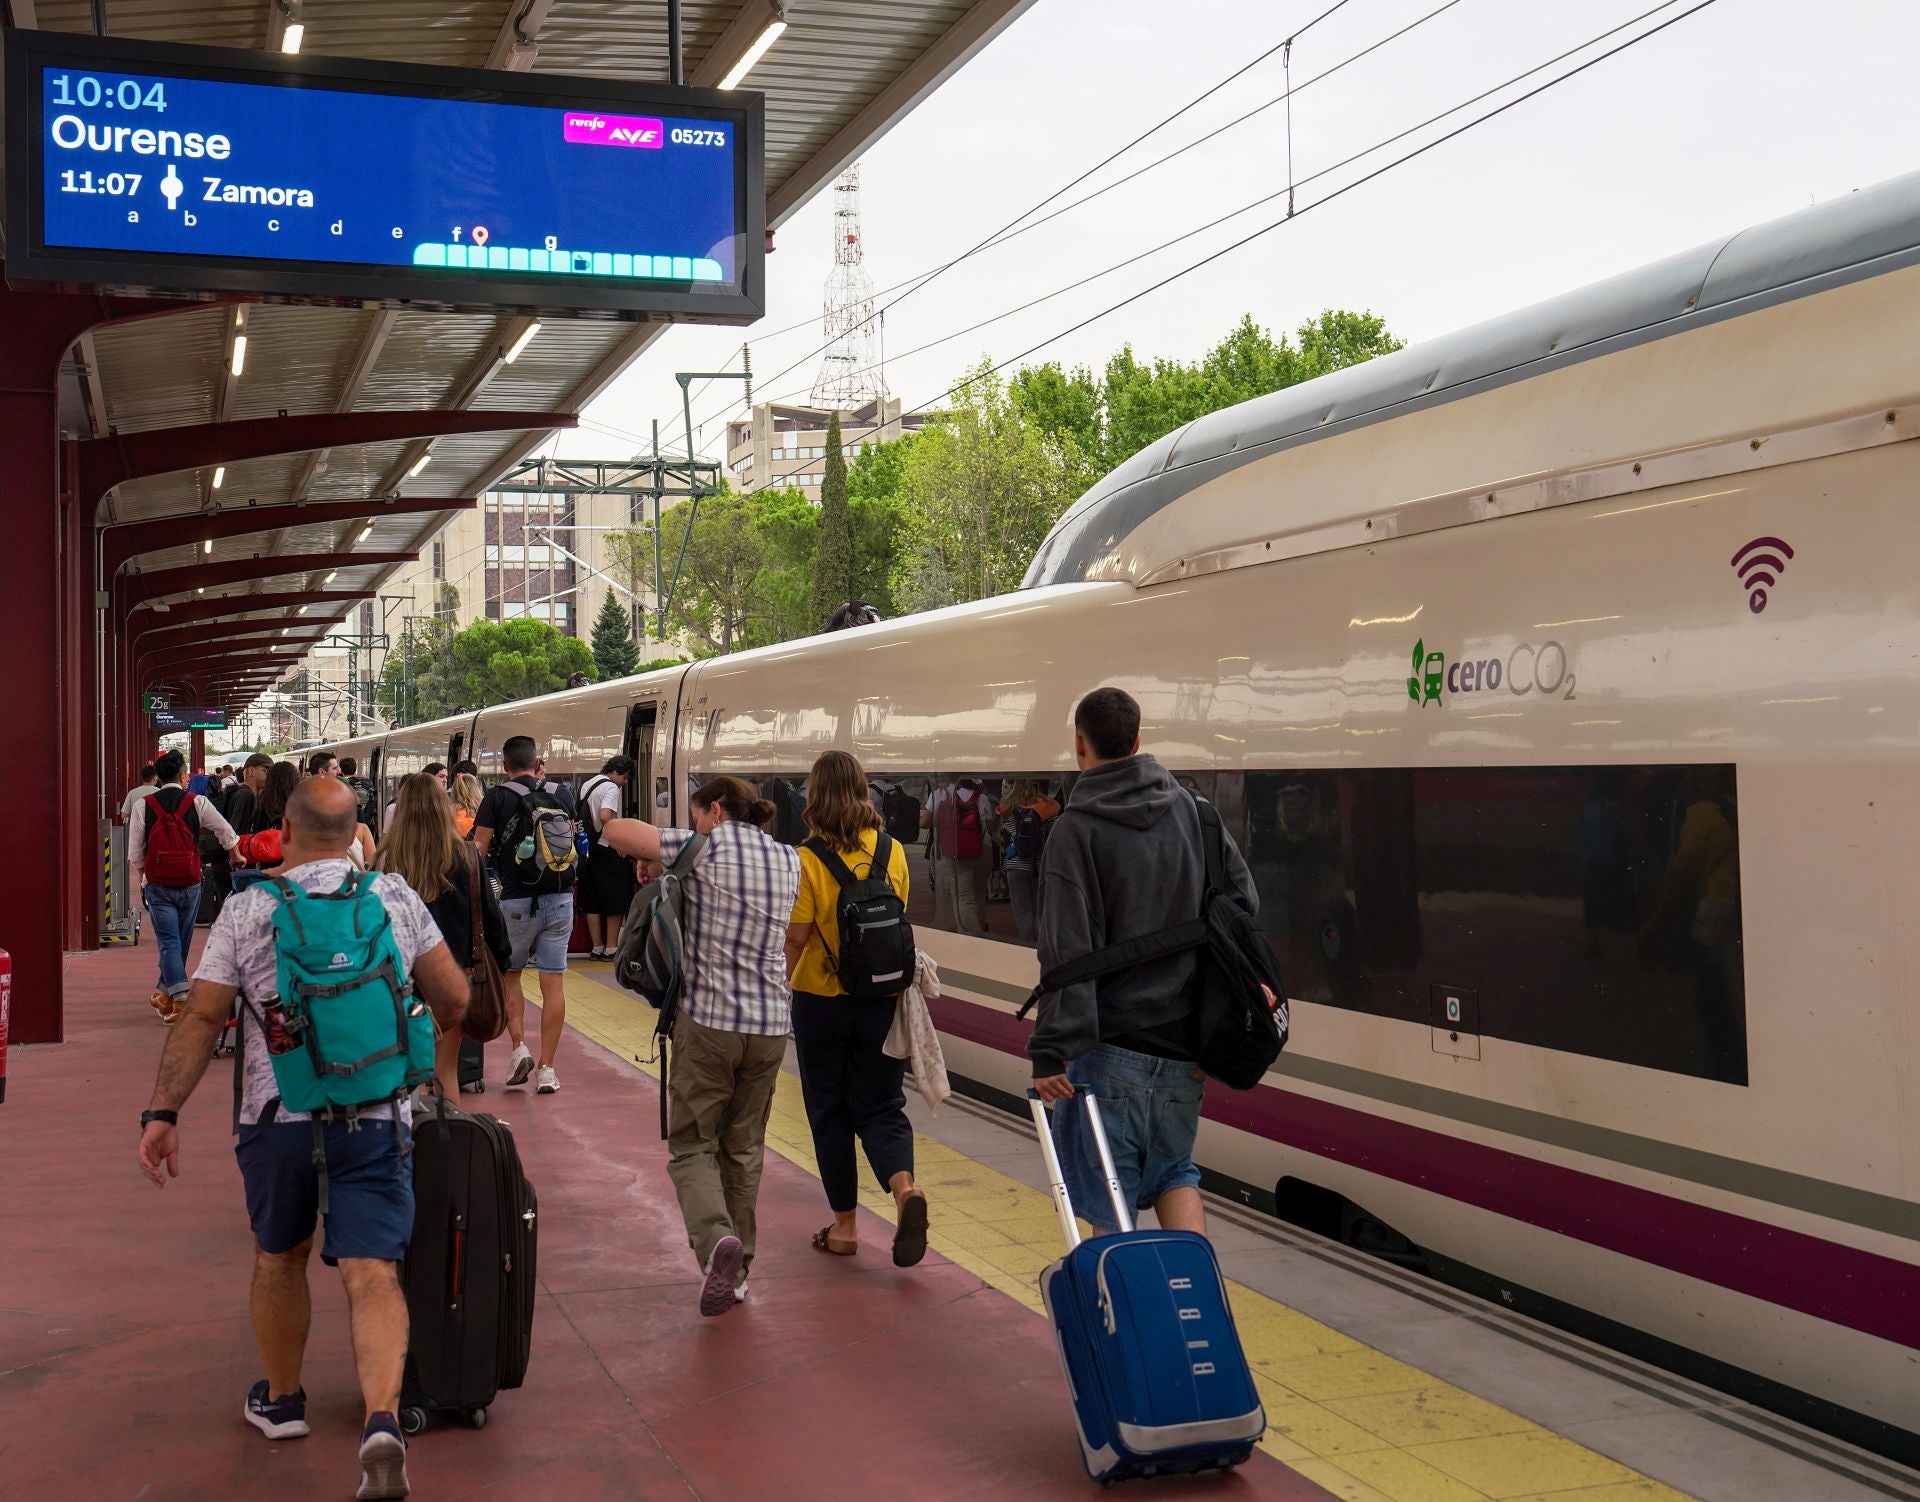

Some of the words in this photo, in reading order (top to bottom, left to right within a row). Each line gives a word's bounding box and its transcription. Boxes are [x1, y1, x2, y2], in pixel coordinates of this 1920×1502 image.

[52, 75, 168, 113] 10:04
[52, 114, 231, 160] Ourense
[569, 117, 606, 131] renfe
[608, 128, 659, 144] AVE
[671, 128, 726, 147] 05273
[61, 170, 143, 197] 11:07
[203, 177, 314, 208] Zamora
[128, 211, 139, 223] a
[184, 210, 198, 227] b
[268, 219, 280, 232] c
[330, 220, 343, 236] d
[391, 226, 403, 239] e
[452, 226, 462, 242] f
[544, 235, 558, 251] g
[1447, 658, 1503, 694] cero
